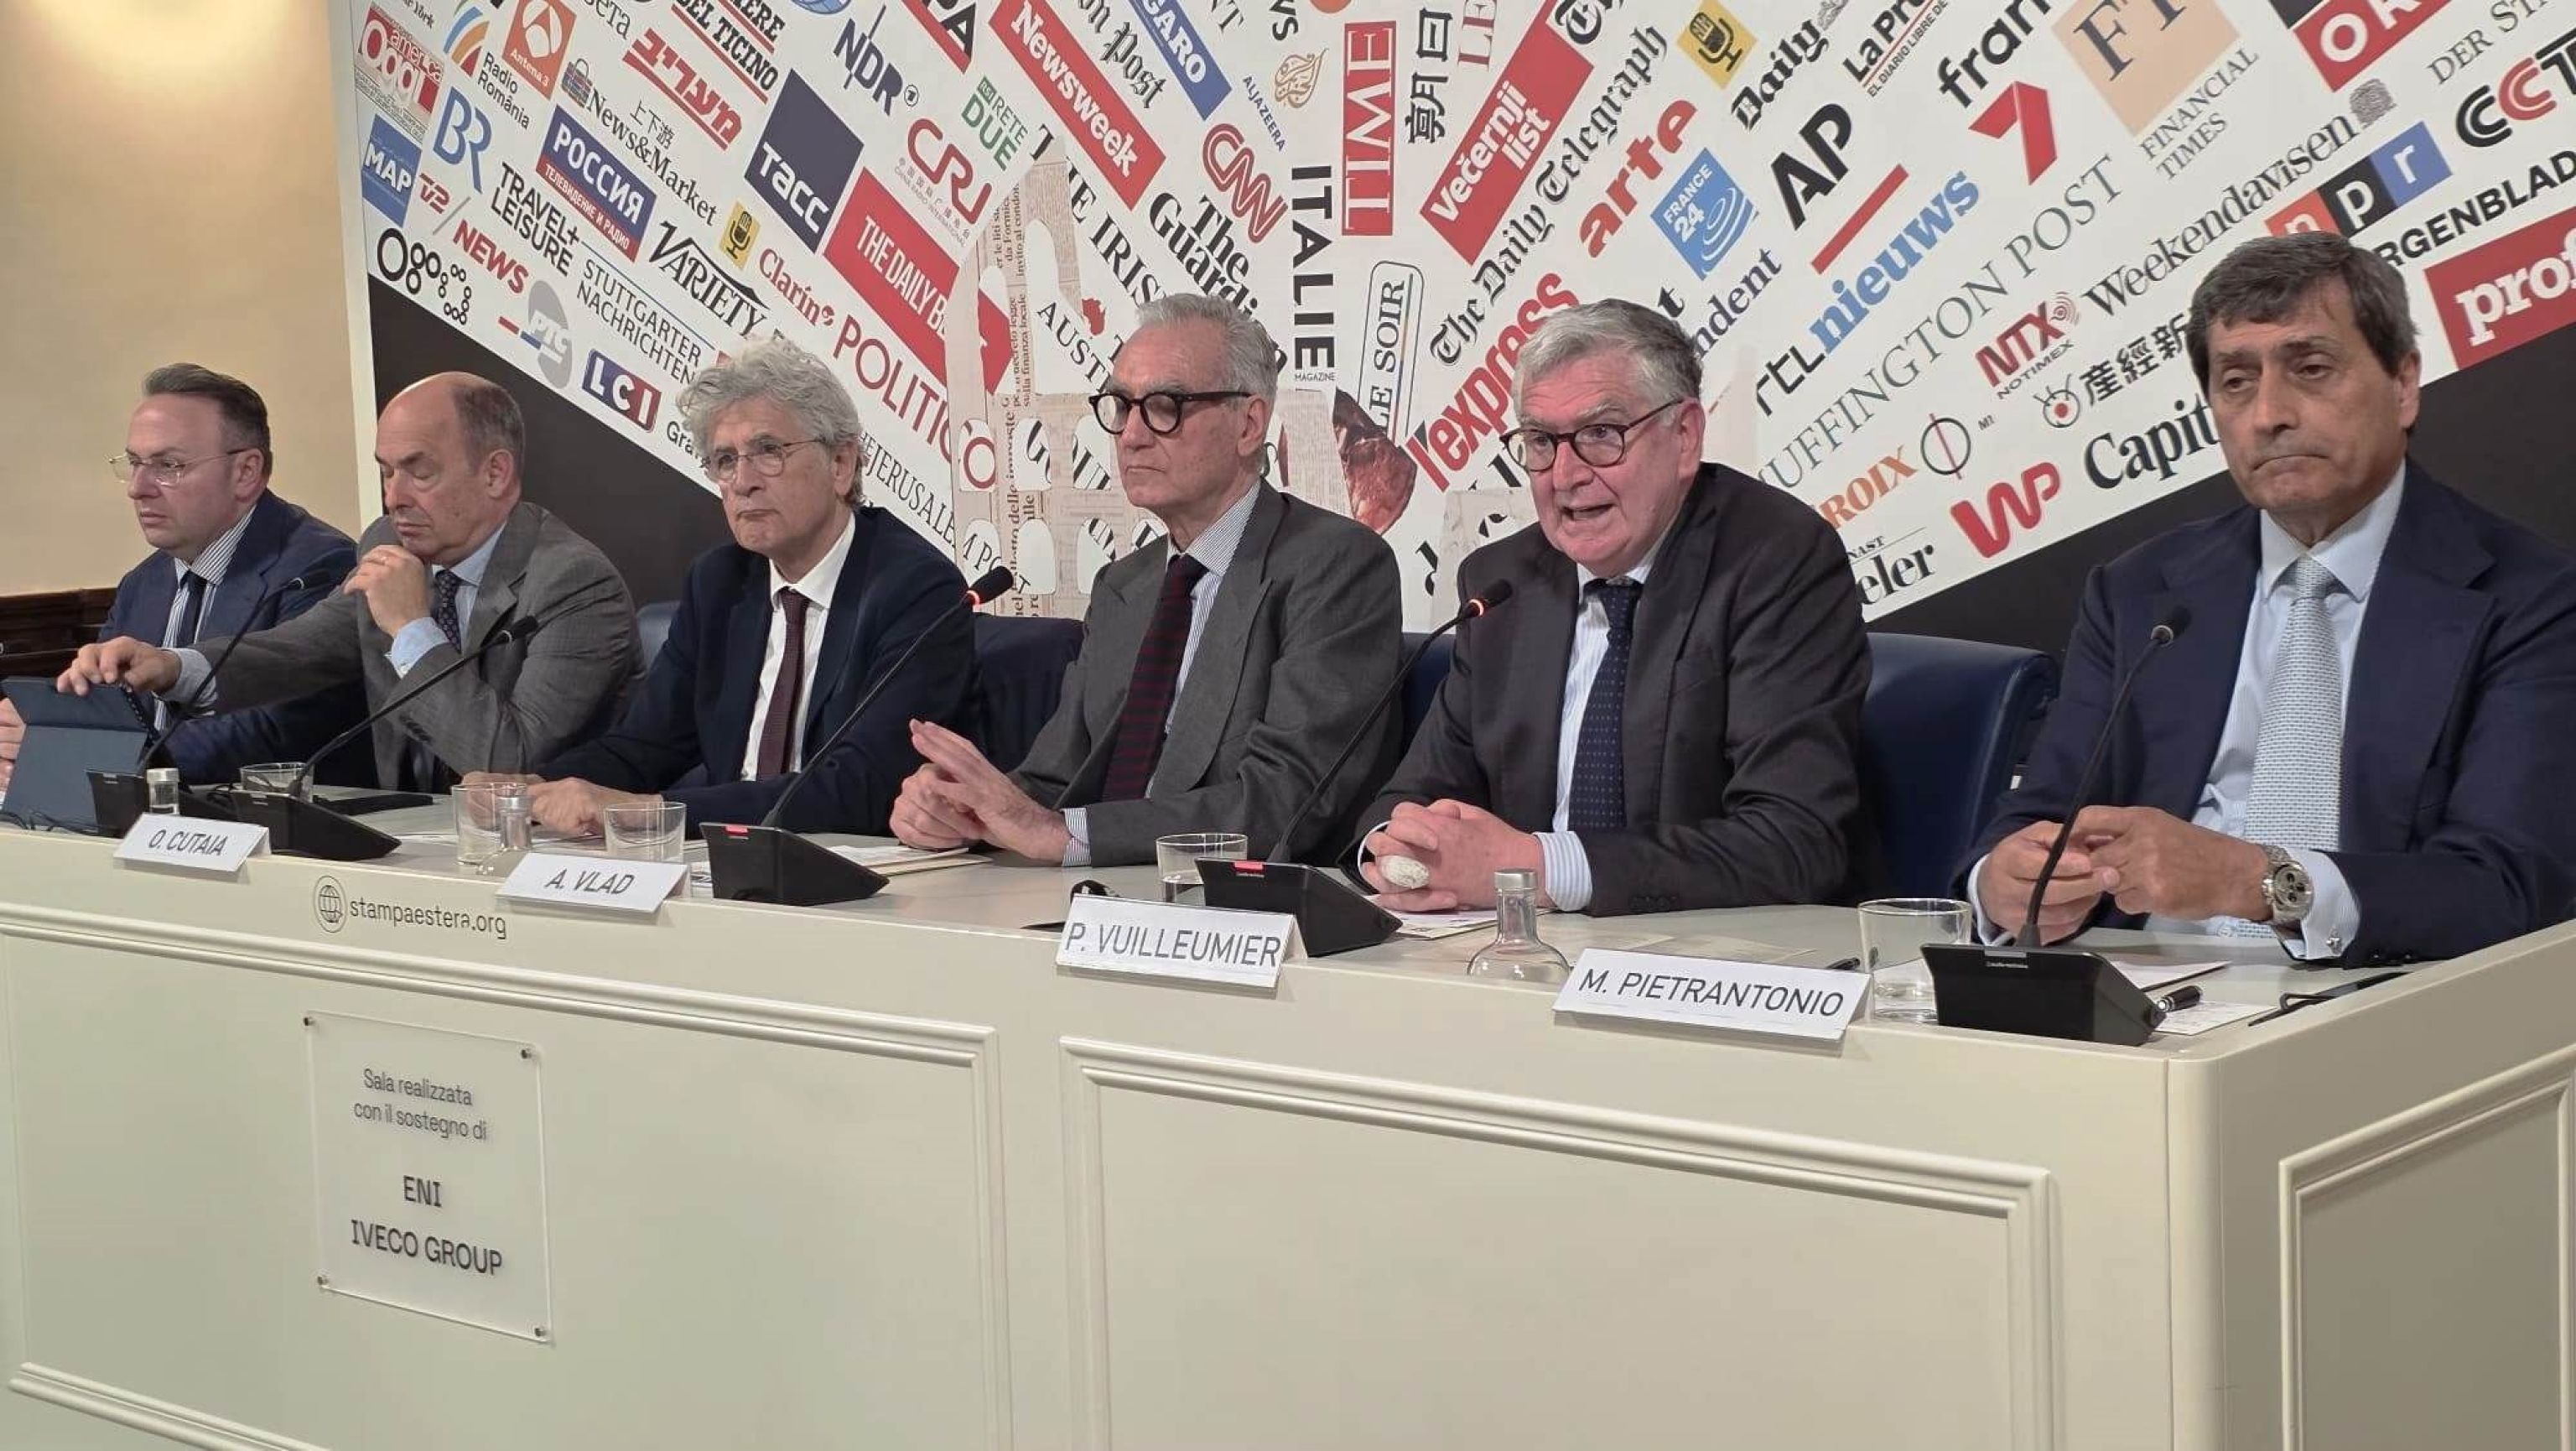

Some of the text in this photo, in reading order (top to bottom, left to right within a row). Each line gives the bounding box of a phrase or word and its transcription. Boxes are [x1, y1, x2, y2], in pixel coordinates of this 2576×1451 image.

[483, 52, 518, 95] Radio
[509, 46, 543, 82] Antena
[712, 16, 779, 91] TICINO
[833, 4, 904, 117] NDR
[1099, 21, 1167, 109] Post
[1731, 18, 1830, 132] Daily
[1867, 81, 1883, 97] EL
[1878, 46, 1911, 85] DIARIO
[1909, 13, 1936, 53] LIBRE
[2426, 0, 2548, 85] DER ST
[478, 72, 531, 129] România
[961, 93, 1018, 172] DUE
[992, 96, 1028, 146] RETE
[1010, 4, 1139, 177] Newsweek
[1241, 75, 1287, 152] ALJAZEERA
[1344, 28, 1394, 231] TIME
[2139, 45, 2260, 161] FINANCIAL
[364, 143, 413, 194] MAP
[433, 86, 492, 194] BR
[553, 122, 646, 226] РОССИЯ
[587, 90, 718, 227] News&Market
[1431, 81, 1528, 223] Večernji
[1501, 107, 1550, 171] list
[1578, 99, 1698, 258] arte
[1770, 102, 1853, 231] AP
[2156, 112, 2229, 181] TIMES
[499, 162, 580, 246] TRAVEL+
[1202, 122, 1290, 244] CNN
[1429, 299, 1486, 365] The
[1472, 204, 1555, 307] Daily
[1535, 24, 1669, 205] Telegraph
[1662, 164, 1713, 226] FRANCE
[1673, 200, 1706, 244] 24
[2003, 153, 2123, 279] POST
[2081, 114, 2358, 319] Weekendavisen
[2285, 143, 2417, 233] npr
[453, 219, 530, 295] NEWS
[490, 186, 571, 277] LEISURE
[602, 217, 630, 250] РАДИО
[855, 215, 894, 274] THE
[884, 248, 937, 315] DAILY
[1088, 211, 1167, 309] IRIS
[1190, 194, 1250, 285] The
[1291, 165, 1336, 371] ITALIE
[1808, 169, 1980, 355] nieuws
[582, 259, 704, 367] STUTTGARTER
[648, 220, 771, 338] VARIETY
[576, 283, 698, 386] NACHRICHTEN
[1374, 280, 1405, 372] SOIR
[1975, 299, 2066, 387] NTX
[1997, 338, 2075, 400] NOTIMEX
[589, 358, 652, 425] LCI
[1294, 371, 1337, 382] MAGAZINE
[1818, 445, 1919, 531] ROIX
[1950, 460, 2061, 559] WP
[147, 830, 228, 857] O. CUTAIA
[543, 871, 635, 896] A. VLAD
[349, 897, 507, 941] stampaestera.org
[1064, 923, 1281, 967] P. VUILLEUMIER
[1578, 968, 1844, 1017] M. PIETRANTONIO
[353, 1101, 487, 1141] con il sostegno di
[362, 1069, 473, 1106] Sala realizzata
[402, 1174, 443, 1209] ENI
[350, 1219, 503, 1277] IVECO GROUP
